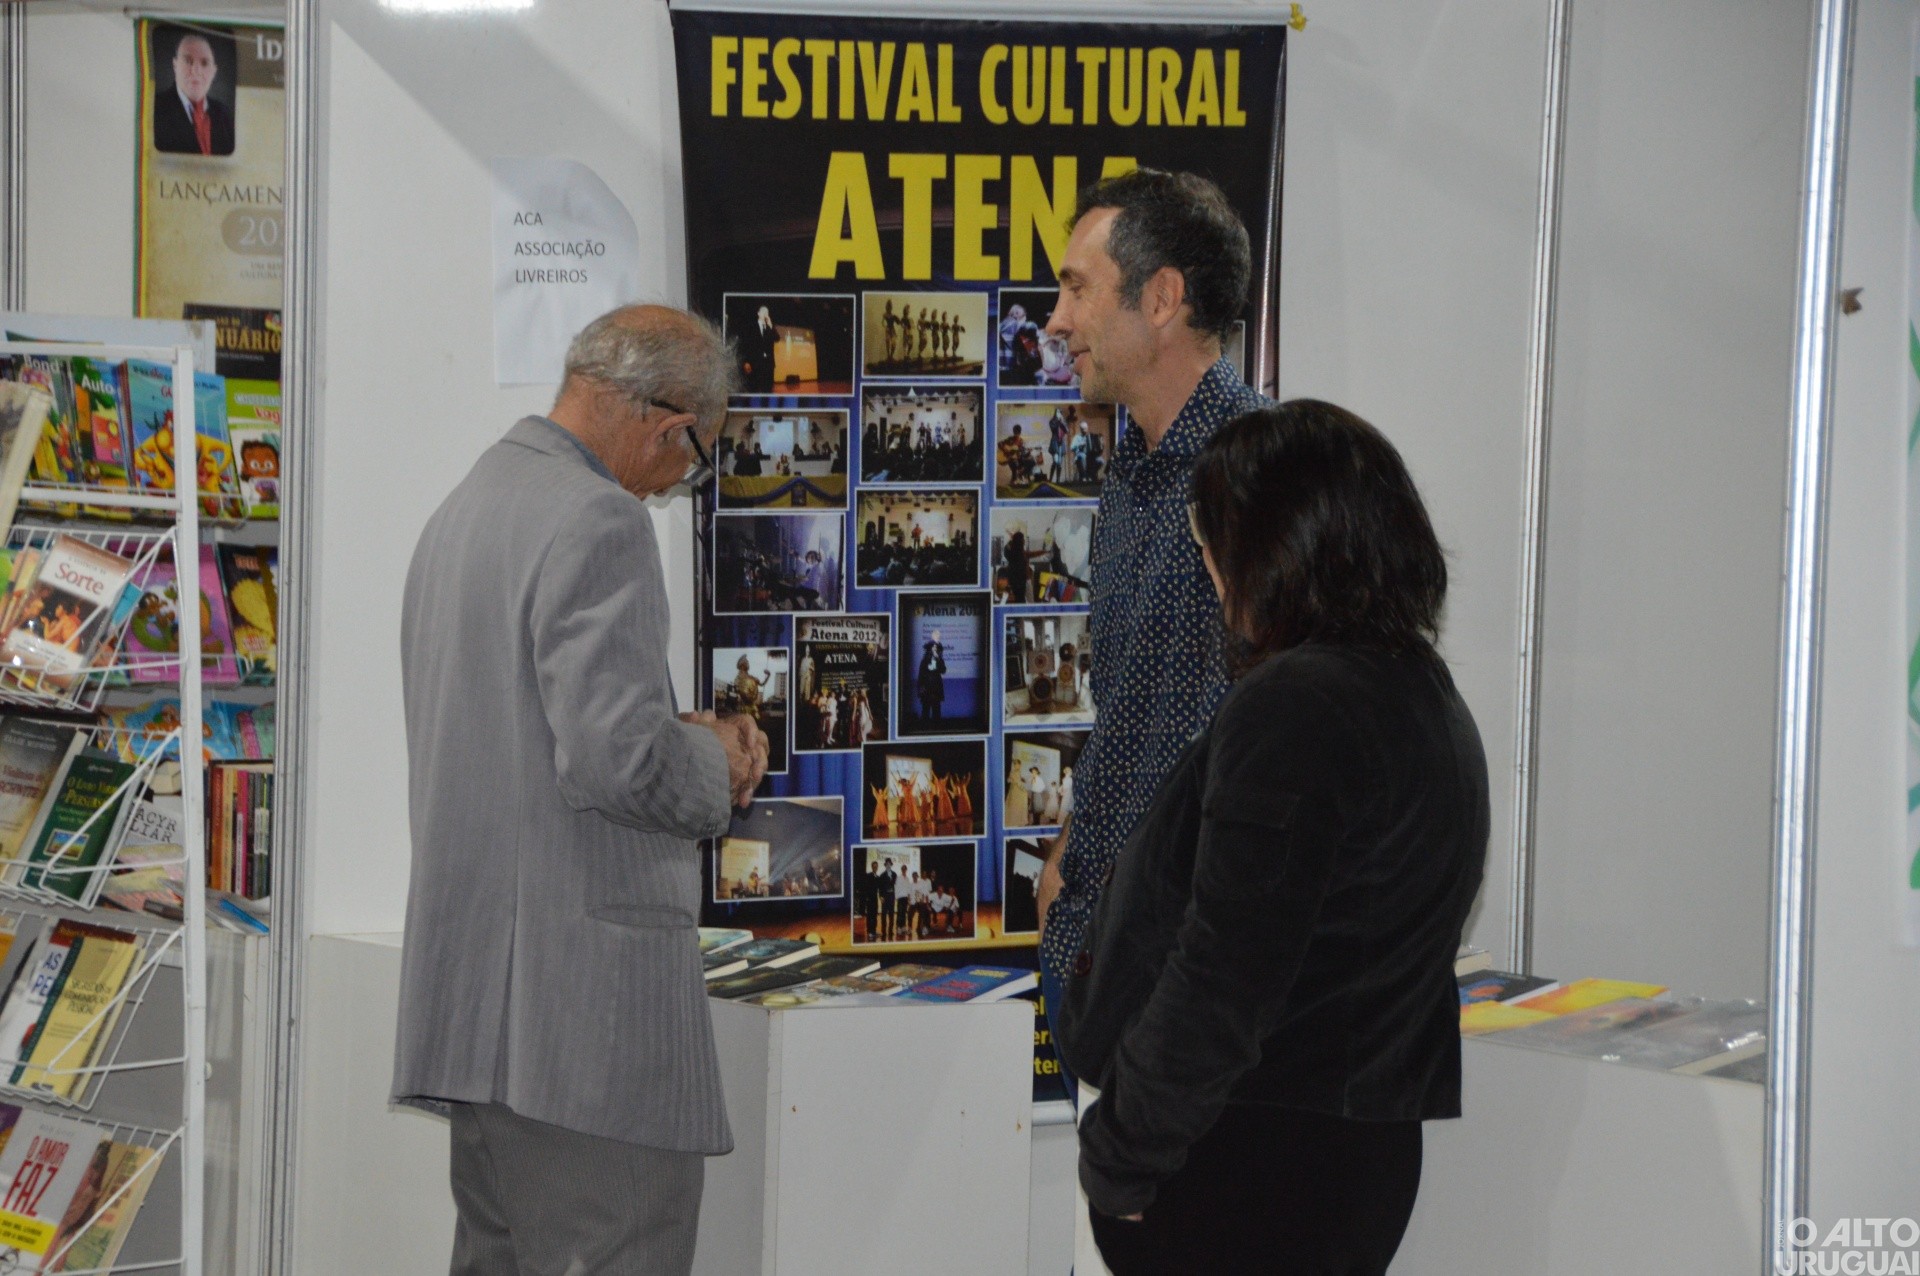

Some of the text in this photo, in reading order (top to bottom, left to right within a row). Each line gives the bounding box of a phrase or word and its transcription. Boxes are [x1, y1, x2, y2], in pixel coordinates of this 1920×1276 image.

[711, 36, 1247, 127] FESTIVAL CULTURAL
[514, 212, 543, 226] ACA
[808, 151, 1141, 282] ATEN
[514, 240, 606, 259] ASSOCIAÇÃO
[515, 269, 588, 284] LIVREIROS
[55, 563, 104, 595] Sorte
[810, 628, 877, 641] Atena 2012
[824, 653, 858, 663] ATENA
[2, 1160, 59, 1217] FAZ
